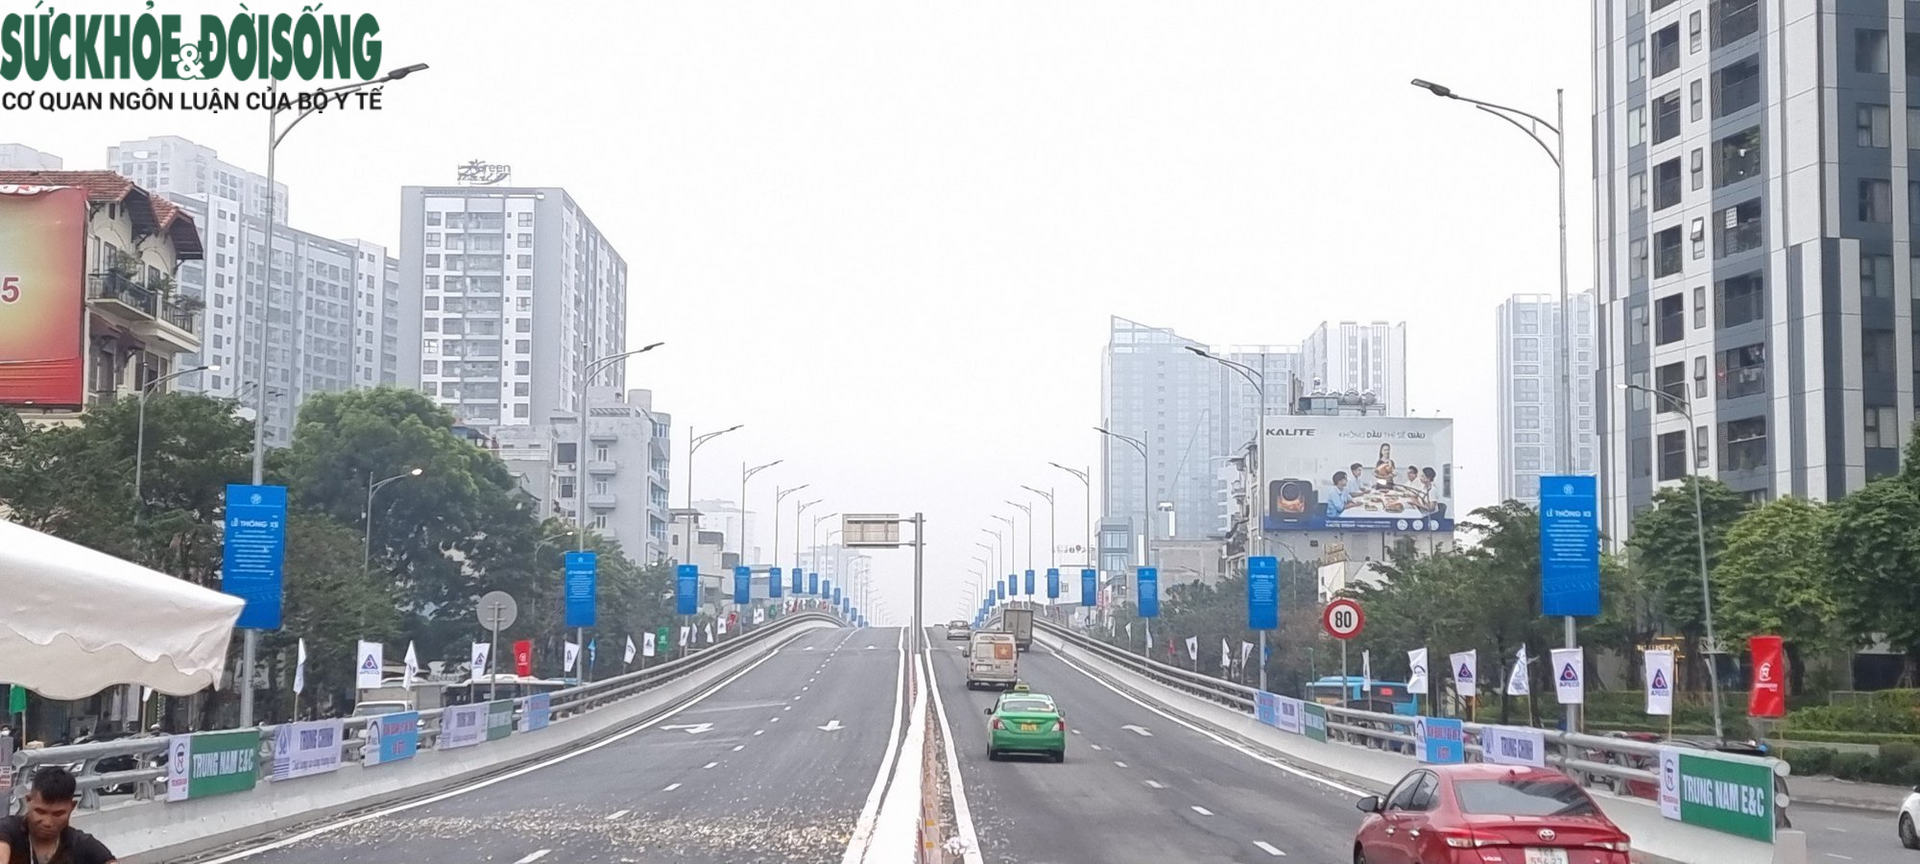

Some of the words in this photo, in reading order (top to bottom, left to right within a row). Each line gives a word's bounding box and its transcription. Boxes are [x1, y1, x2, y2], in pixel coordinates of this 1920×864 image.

[1265, 428, 1316, 437] KALITE
[1335, 611, 1352, 628] 80
[193, 752, 219, 778] TRUNG
[220, 749, 238, 775] NAM
[1682, 774, 1713, 807] TRUNG
[1715, 780, 1739, 812] NAM
[1741, 784, 1765, 818] E&C
